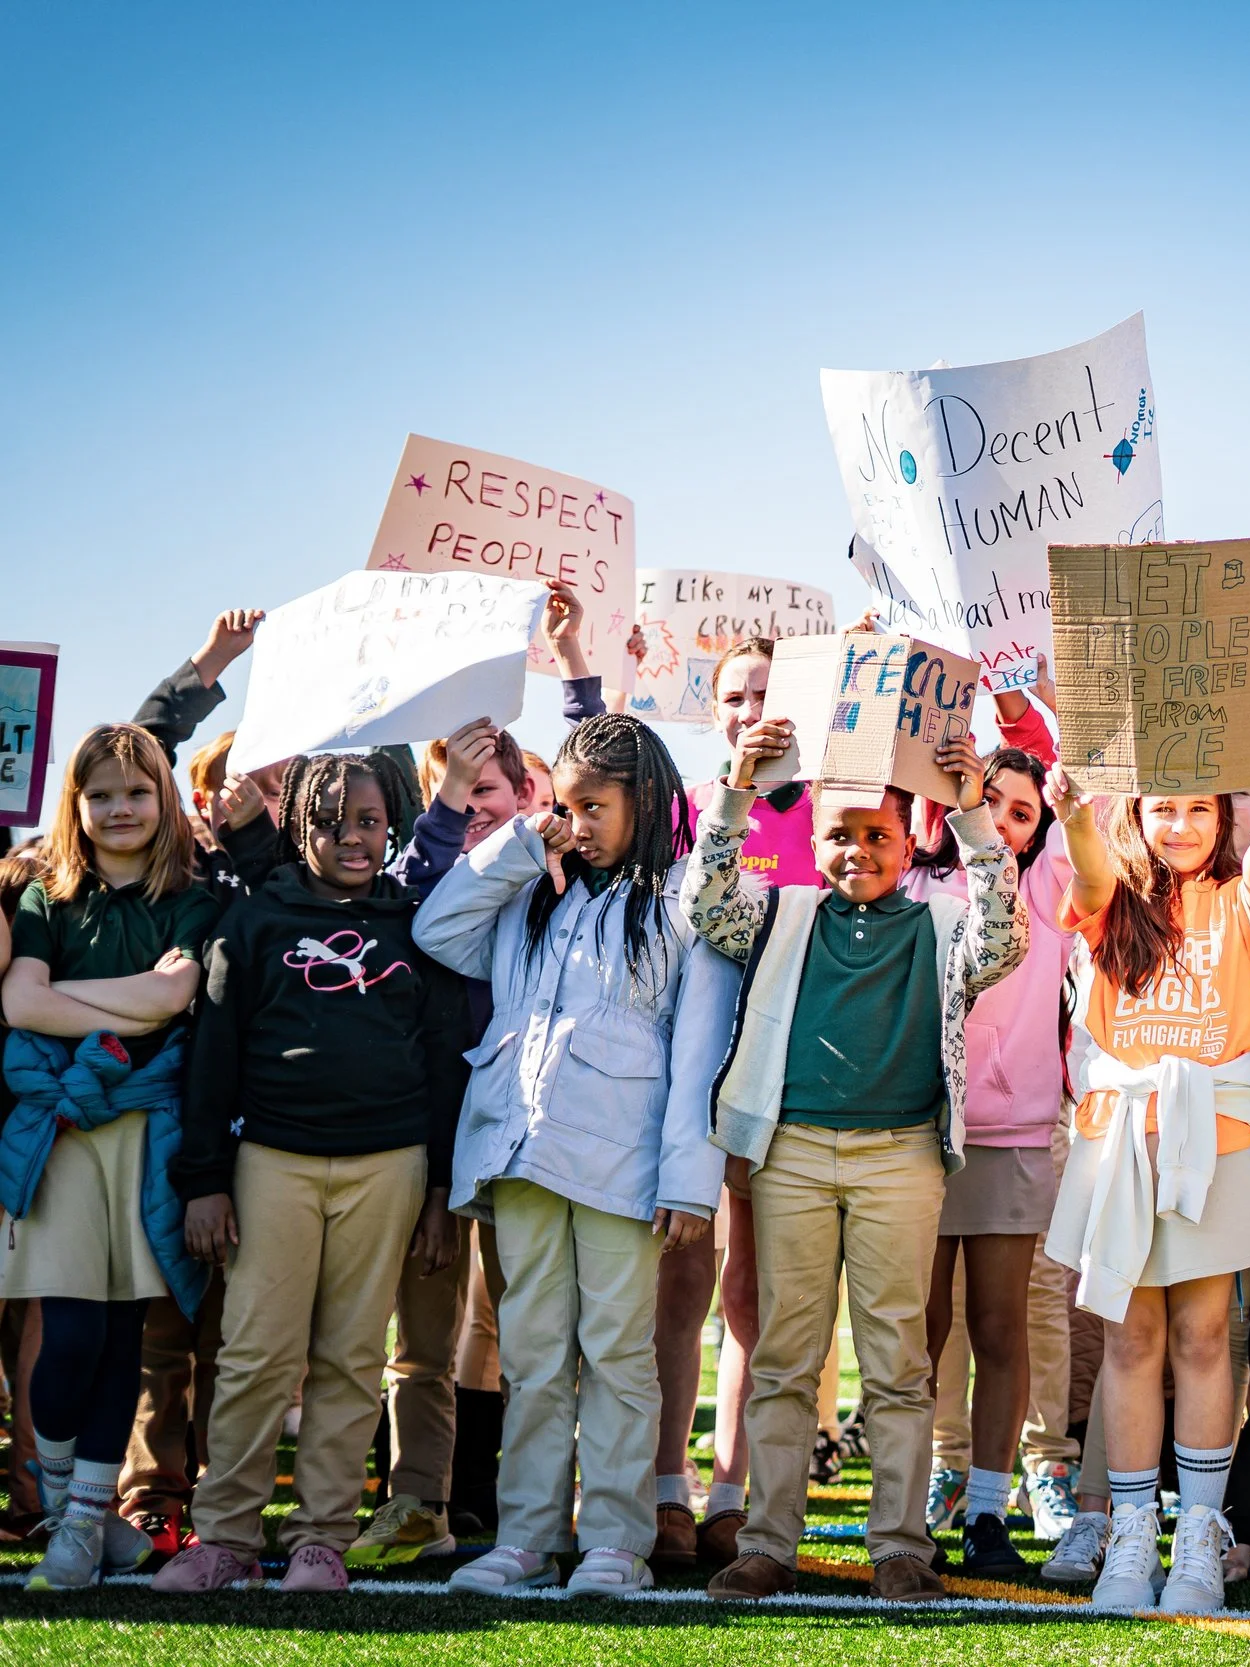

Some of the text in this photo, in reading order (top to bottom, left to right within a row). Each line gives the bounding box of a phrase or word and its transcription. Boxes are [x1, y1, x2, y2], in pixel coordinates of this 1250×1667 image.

[923, 365, 1115, 478] Decent
[444, 460, 623, 546] RESPECT
[938, 471, 1084, 555] HUMAN
[427, 523, 610, 594] PEOPLE'S
[1103, 548, 1212, 617] LET
[931, 567, 1009, 630] heart
[1087, 616, 1250, 670] PEOPLE
[1100, 661, 1247, 706] BE FREE
[1105, 726, 1226, 794] ICE
[1113, 1024, 1202, 1050] FLY HIGHER
